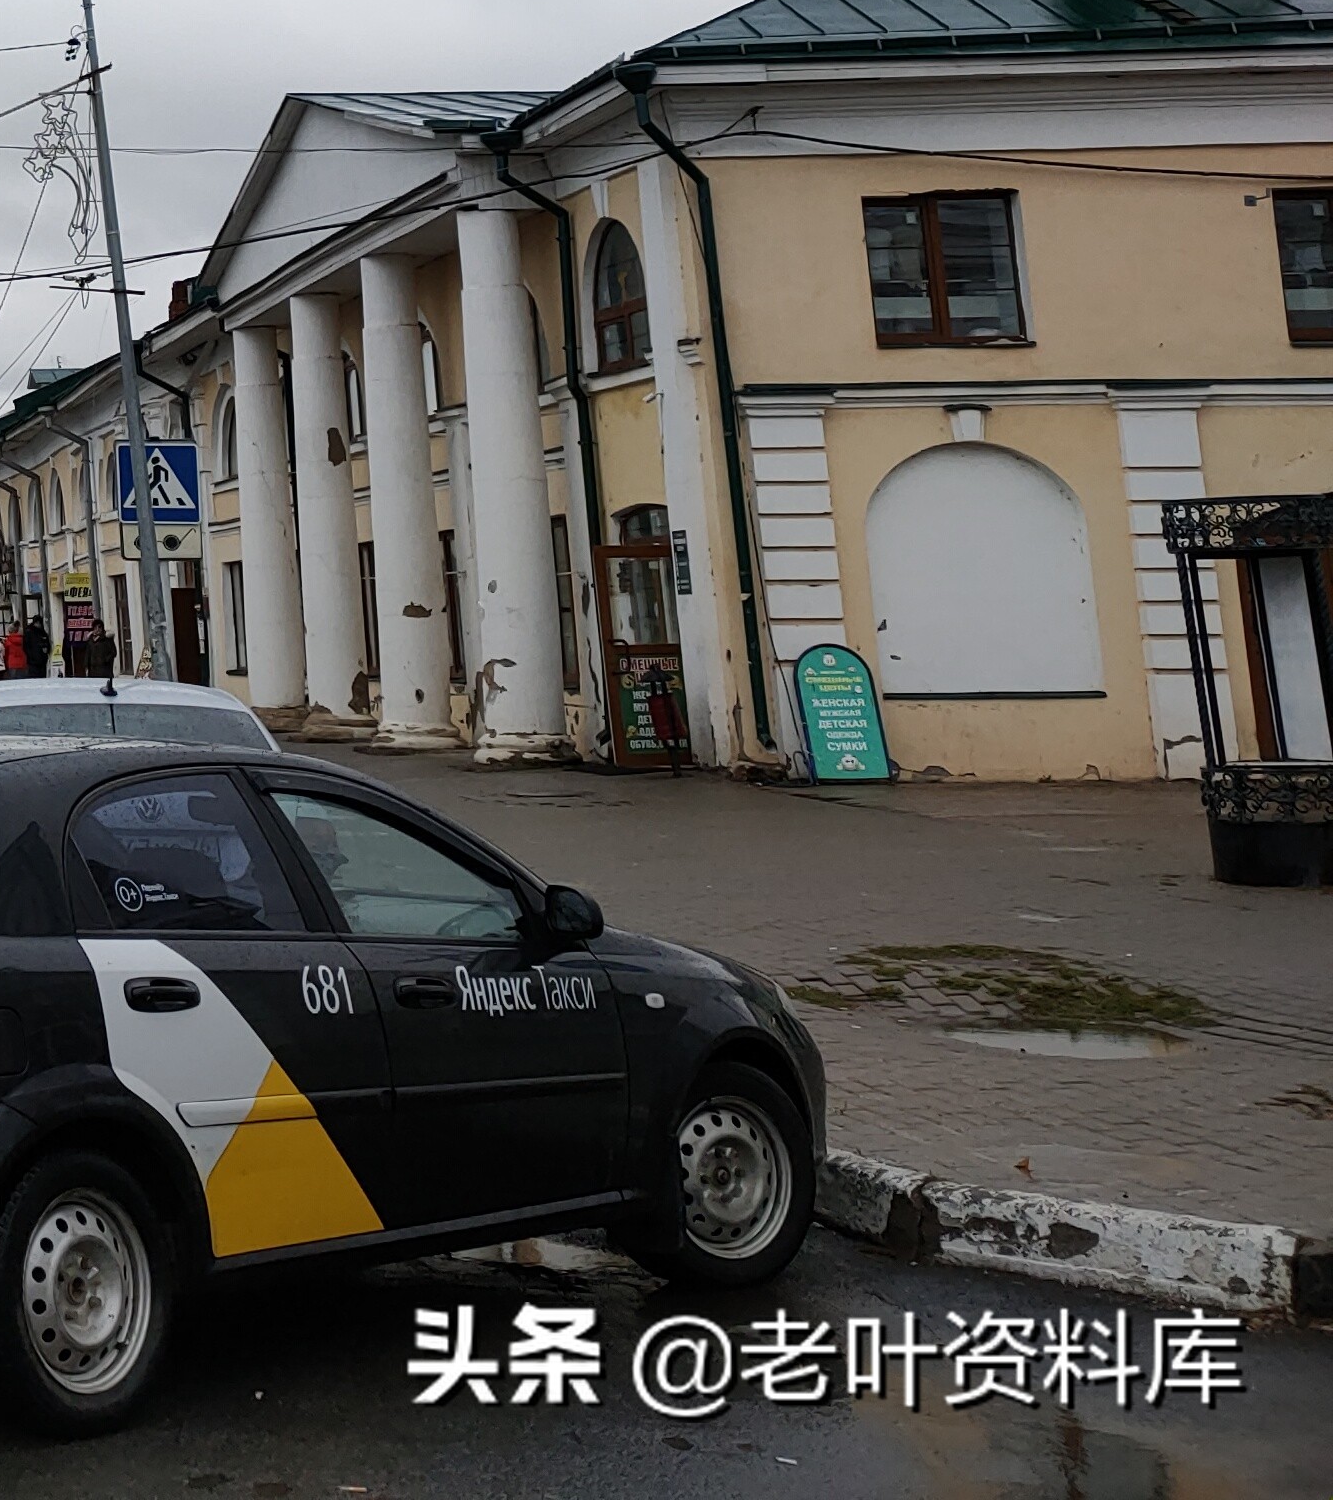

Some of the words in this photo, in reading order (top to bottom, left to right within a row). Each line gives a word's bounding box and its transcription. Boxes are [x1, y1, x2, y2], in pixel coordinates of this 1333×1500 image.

[812, 699, 866, 707] ЖЕНСКАЯ
[819, 719, 868, 729] ДЕТСКАЯ
[827, 741, 868, 751] СУМКИ
[301, 965, 354, 1014] 681
[455, 965, 536, 1017] Яндекс
[531, 965, 597, 1010] Такси
